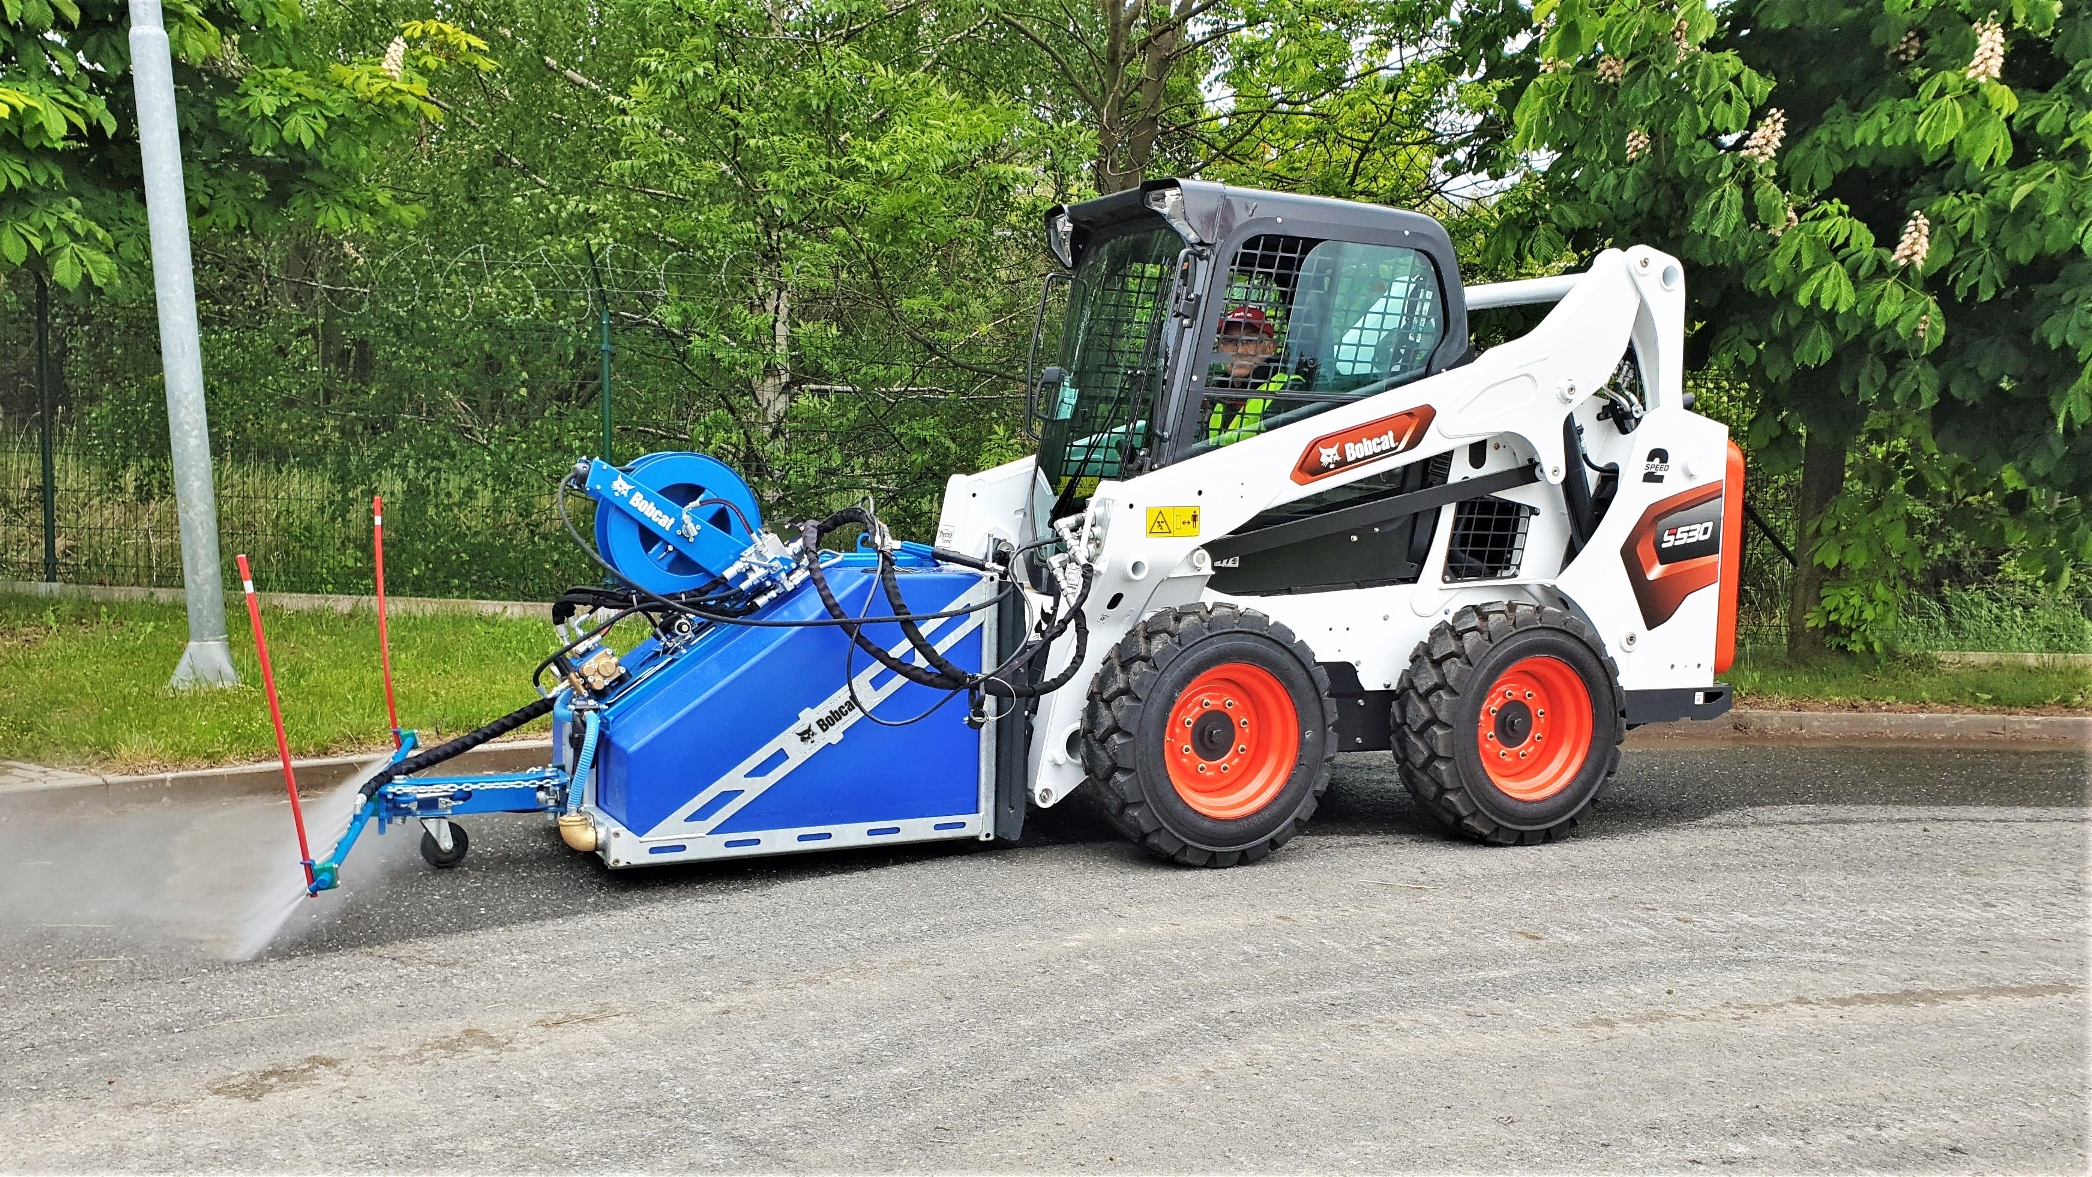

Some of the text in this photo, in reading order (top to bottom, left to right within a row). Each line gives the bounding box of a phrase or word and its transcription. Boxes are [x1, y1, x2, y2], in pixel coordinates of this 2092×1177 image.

[1344, 430, 1397, 462] Bobcat
[1642, 447, 1669, 484] 2
[1644, 463, 1670, 472] SPEED
[628, 490, 676, 532] Bobcat
[1661, 521, 1714, 549] S530
